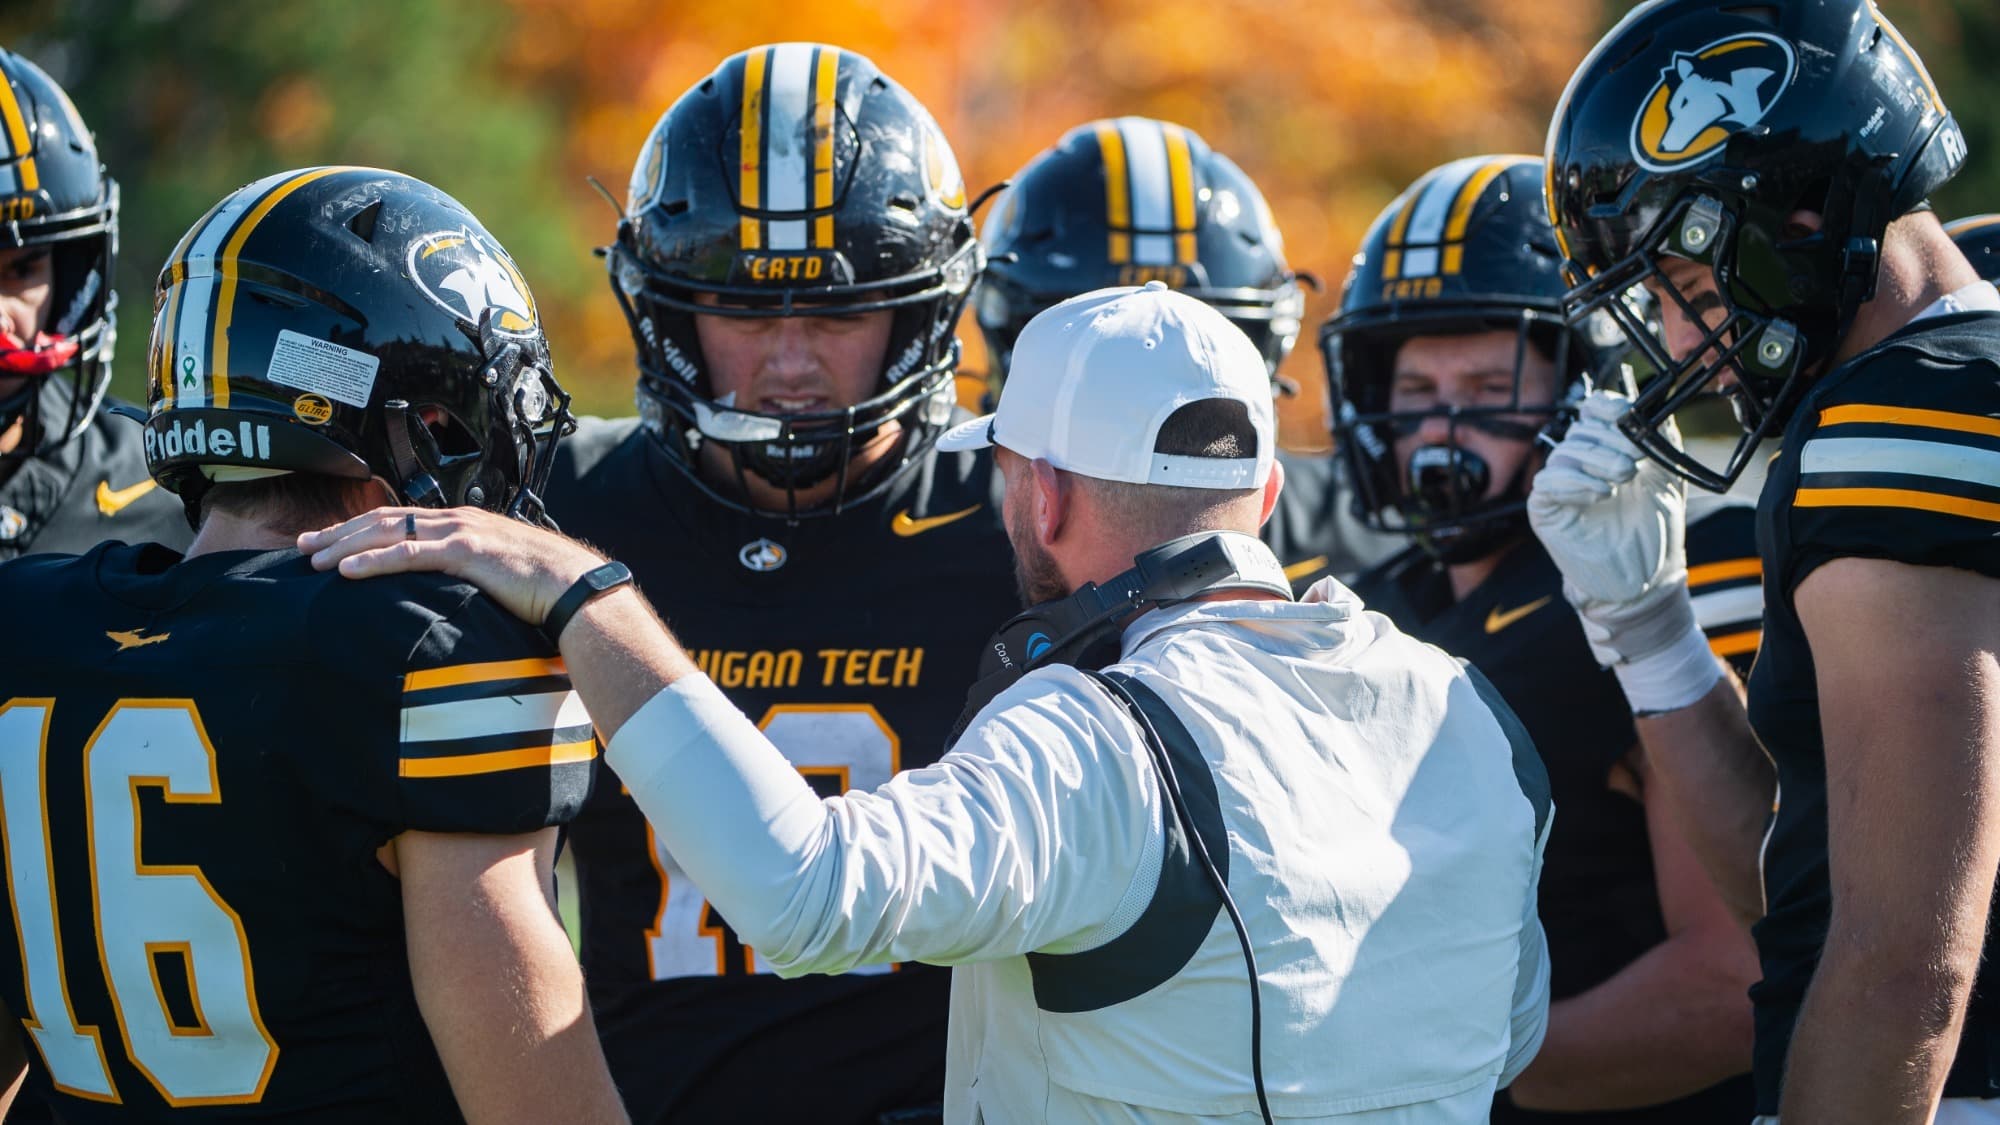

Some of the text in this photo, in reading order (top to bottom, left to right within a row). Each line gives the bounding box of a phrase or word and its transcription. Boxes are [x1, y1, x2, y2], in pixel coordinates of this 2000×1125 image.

[310, 339, 348, 356] WARNING
[144, 418, 270, 464] Riddell
[817, 648, 924, 687] TECH
[994, 642, 1014, 670] Coac
[0, 697, 280, 1107] 16
